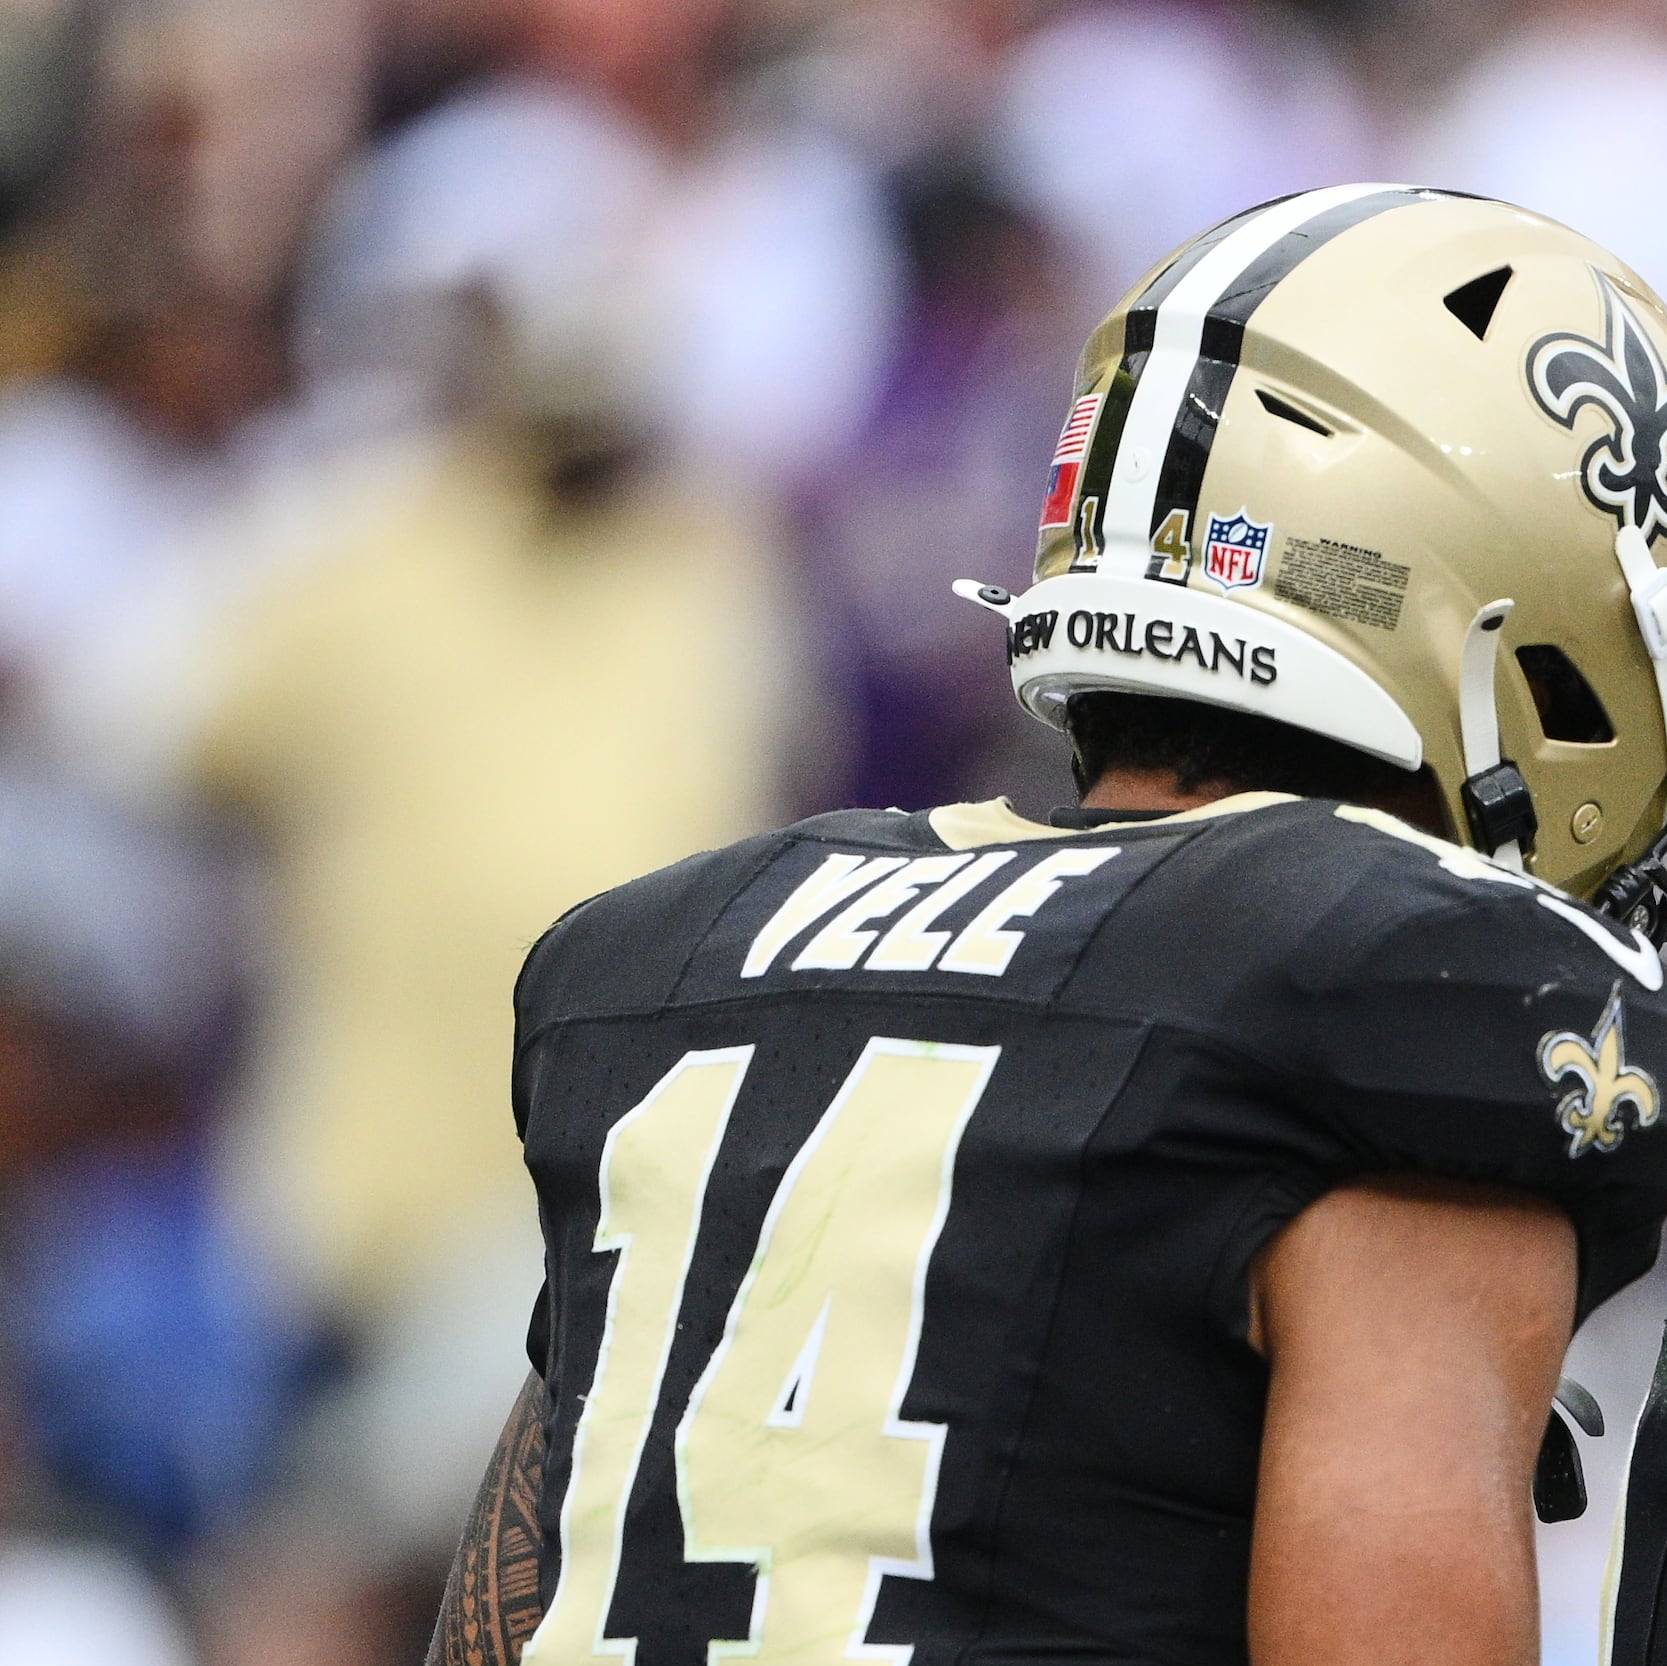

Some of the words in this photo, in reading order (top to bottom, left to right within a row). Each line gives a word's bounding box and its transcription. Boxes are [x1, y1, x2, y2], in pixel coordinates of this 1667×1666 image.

[1210, 545, 1254, 582] NFL
[1067, 610, 1278, 686] ORLEANS
[740, 846, 1120, 979] VELE
